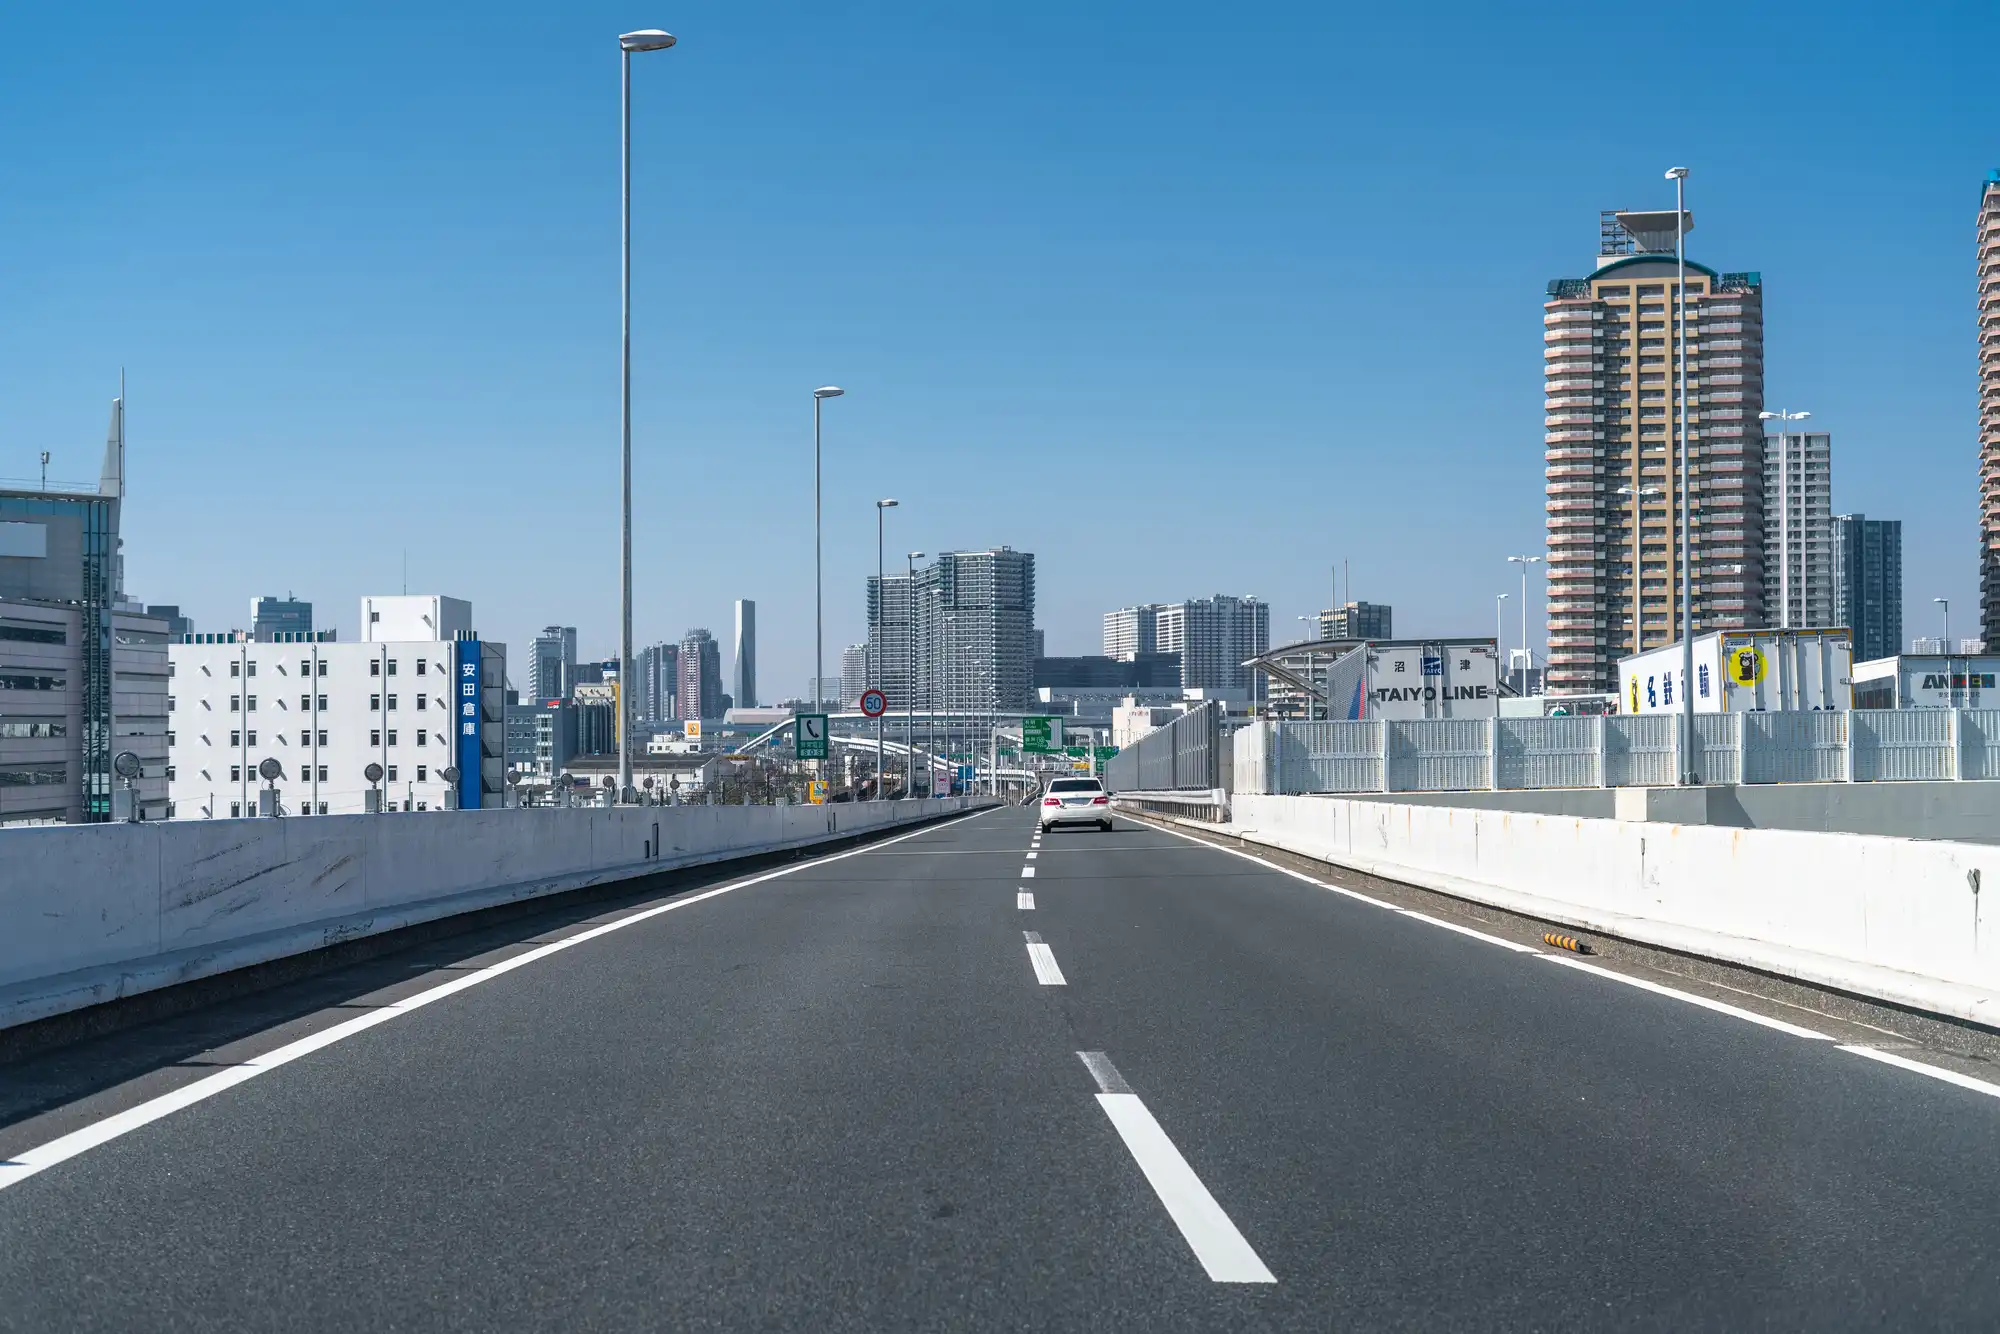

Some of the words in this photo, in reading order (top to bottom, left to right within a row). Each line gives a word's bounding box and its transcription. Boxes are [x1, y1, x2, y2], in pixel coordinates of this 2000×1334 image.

[1394, 661, 1405, 673] 沼
[1460, 659, 1471, 671] 津
[462, 662, 476, 736] 安田倉庫
[1377, 687, 1437, 702] TAIYO
[1442, 685, 1489, 701] LINE
[866, 696, 881, 710] 50
